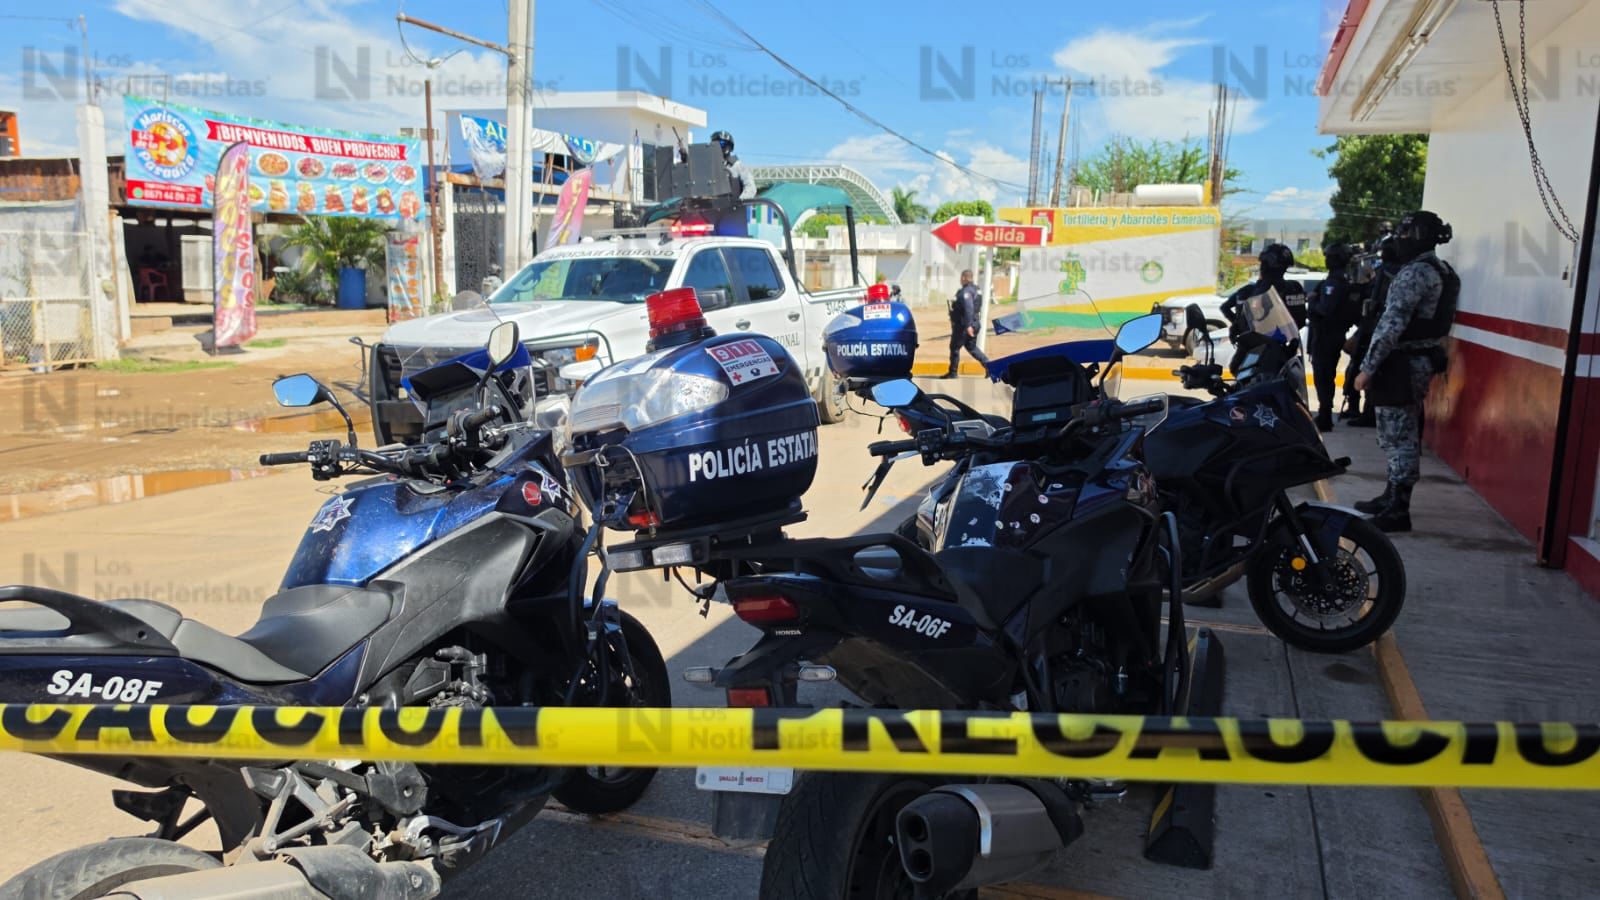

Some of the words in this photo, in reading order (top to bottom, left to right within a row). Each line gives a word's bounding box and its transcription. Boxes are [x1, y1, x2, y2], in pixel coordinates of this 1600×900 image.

[140, 110, 190, 137] Mariscos
[314, 139, 342, 155] BUEN
[344, 143, 401, 160] PROVECHO!
[1120, 213, 1168, 226] Abarrotes
[1171, 213, 1216, 226] Esmeralda
[973, 227, 1025, 244] Salida
[714, 341, 759, 360] 911
[837, 341, 868, 357] POLICÍA
[871, 343, 908, 356] ESTATAL
[725, 356, 772, 373] EMERGENCIAS
[688, 438, 763, 482] POLICÍA
[767, 430, 818, 467] ESTATA
[889, 604, 951, 639] SA-06F
[47, 669, 163, 704] SA-08F
